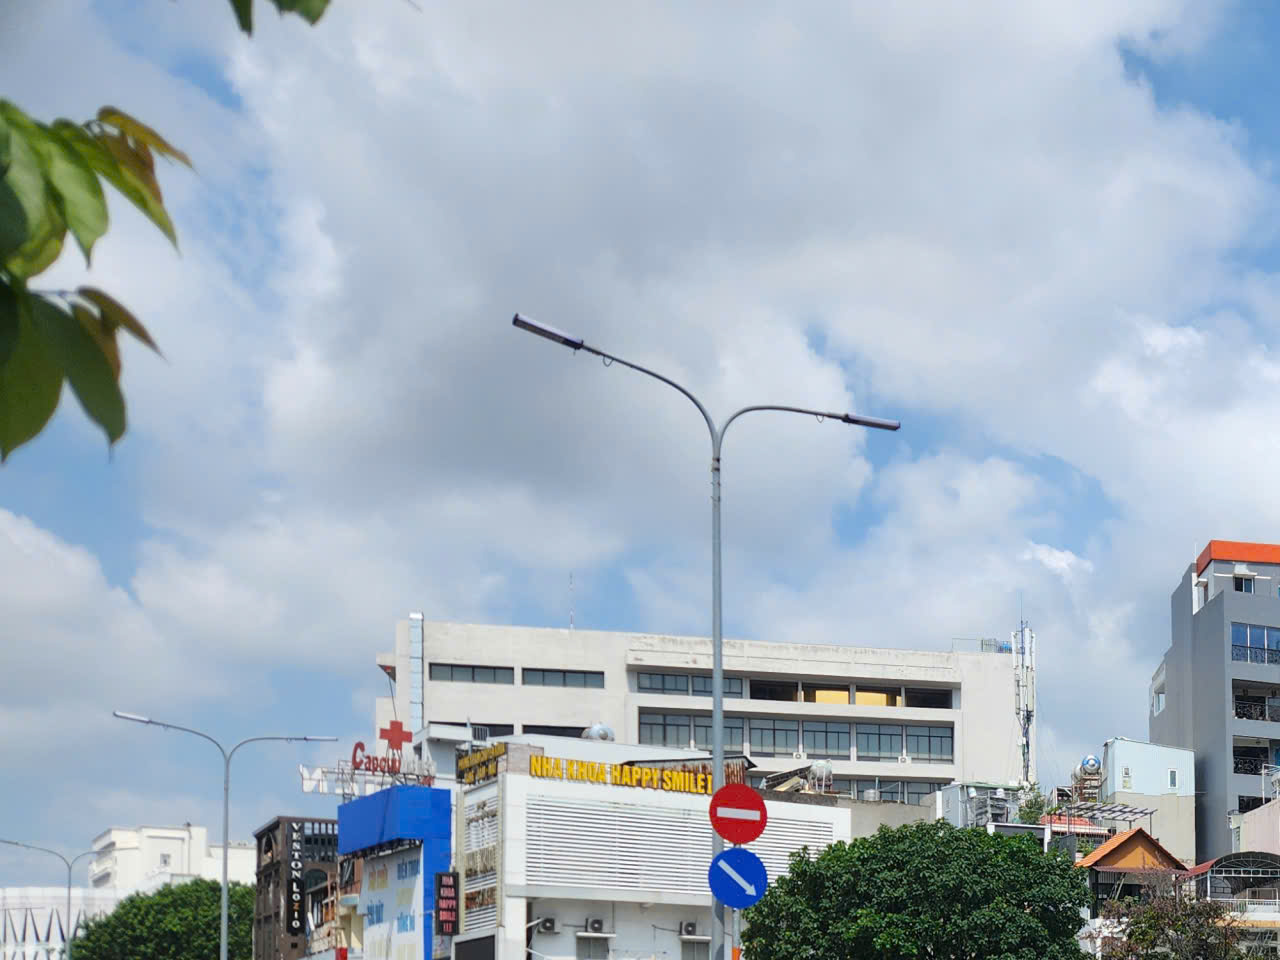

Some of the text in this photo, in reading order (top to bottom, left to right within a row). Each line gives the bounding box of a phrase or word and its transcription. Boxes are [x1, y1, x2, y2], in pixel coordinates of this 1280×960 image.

[530, 753, 562, 780] NHA
[566, 758, 606, 783] KHOA
[610, 763, 660, 789] HAPPY
[662, 769, 705, 795] SMILE
